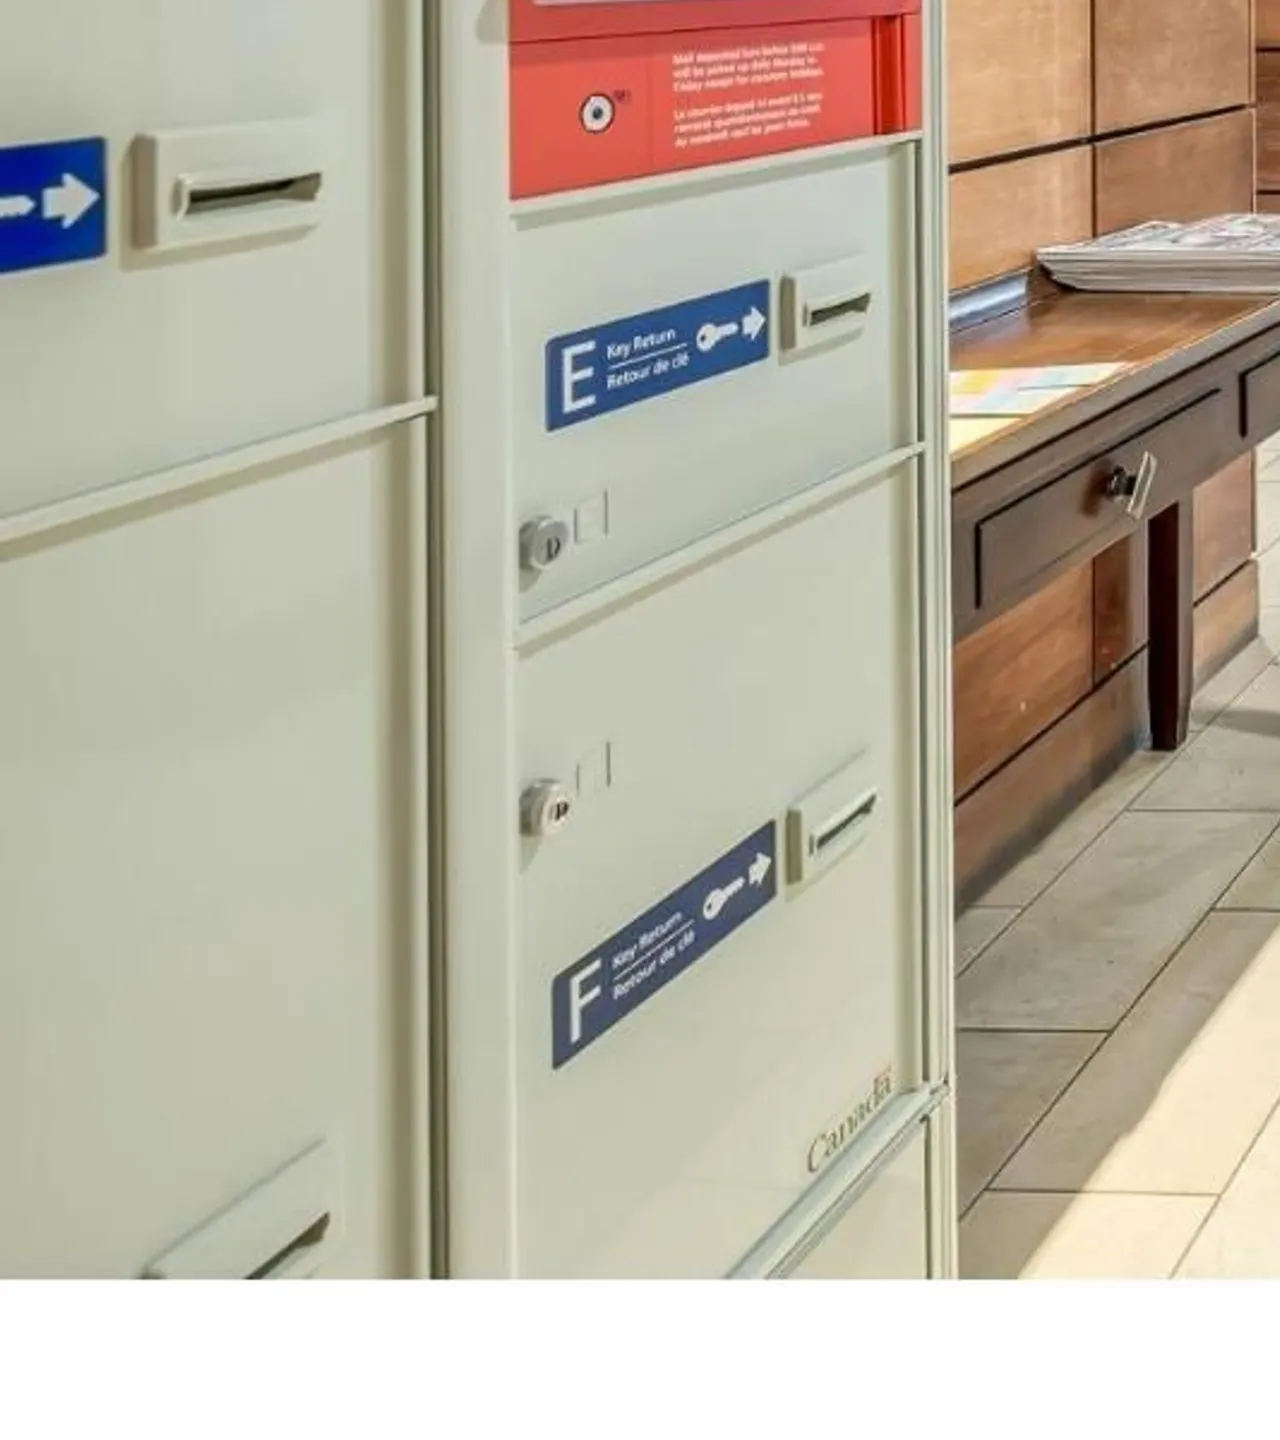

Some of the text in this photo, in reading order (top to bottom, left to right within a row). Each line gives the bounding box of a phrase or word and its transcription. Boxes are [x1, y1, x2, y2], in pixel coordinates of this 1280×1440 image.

[606, 327, 677, 361] Key Return
[562, 340, 597, 415] E
[606, 365, 651, 391] Retour
[652, 358, 670, 375] de
[612, 910, 683, 970] Key Return
[569, 957, 602, 1045] F
[612, 959, 657, 1001] Retour
[807, 1074, 892, 1173] Canada
